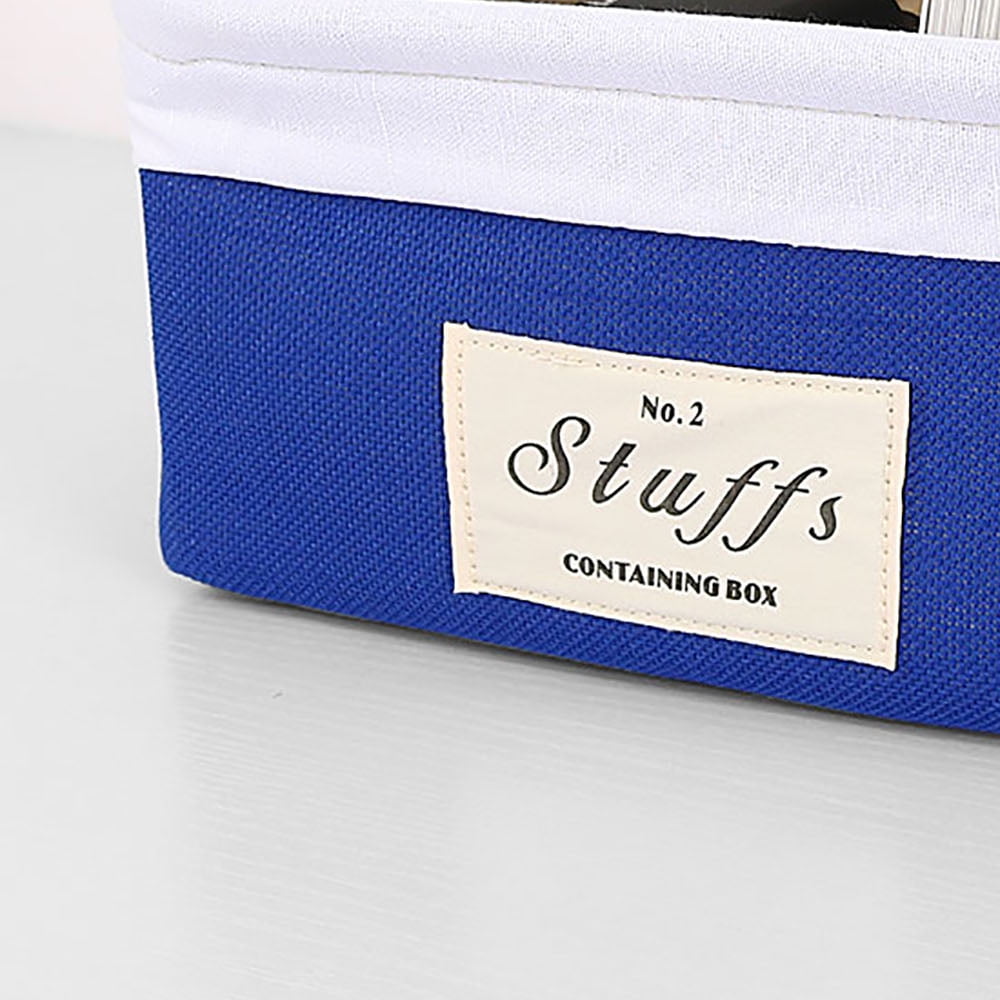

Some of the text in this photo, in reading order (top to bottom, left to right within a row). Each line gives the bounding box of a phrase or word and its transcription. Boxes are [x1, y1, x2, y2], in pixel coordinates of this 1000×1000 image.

[507, 415, 843, 553] Stuffs
[563, 553, 778, 608] CONTAINING BOX
